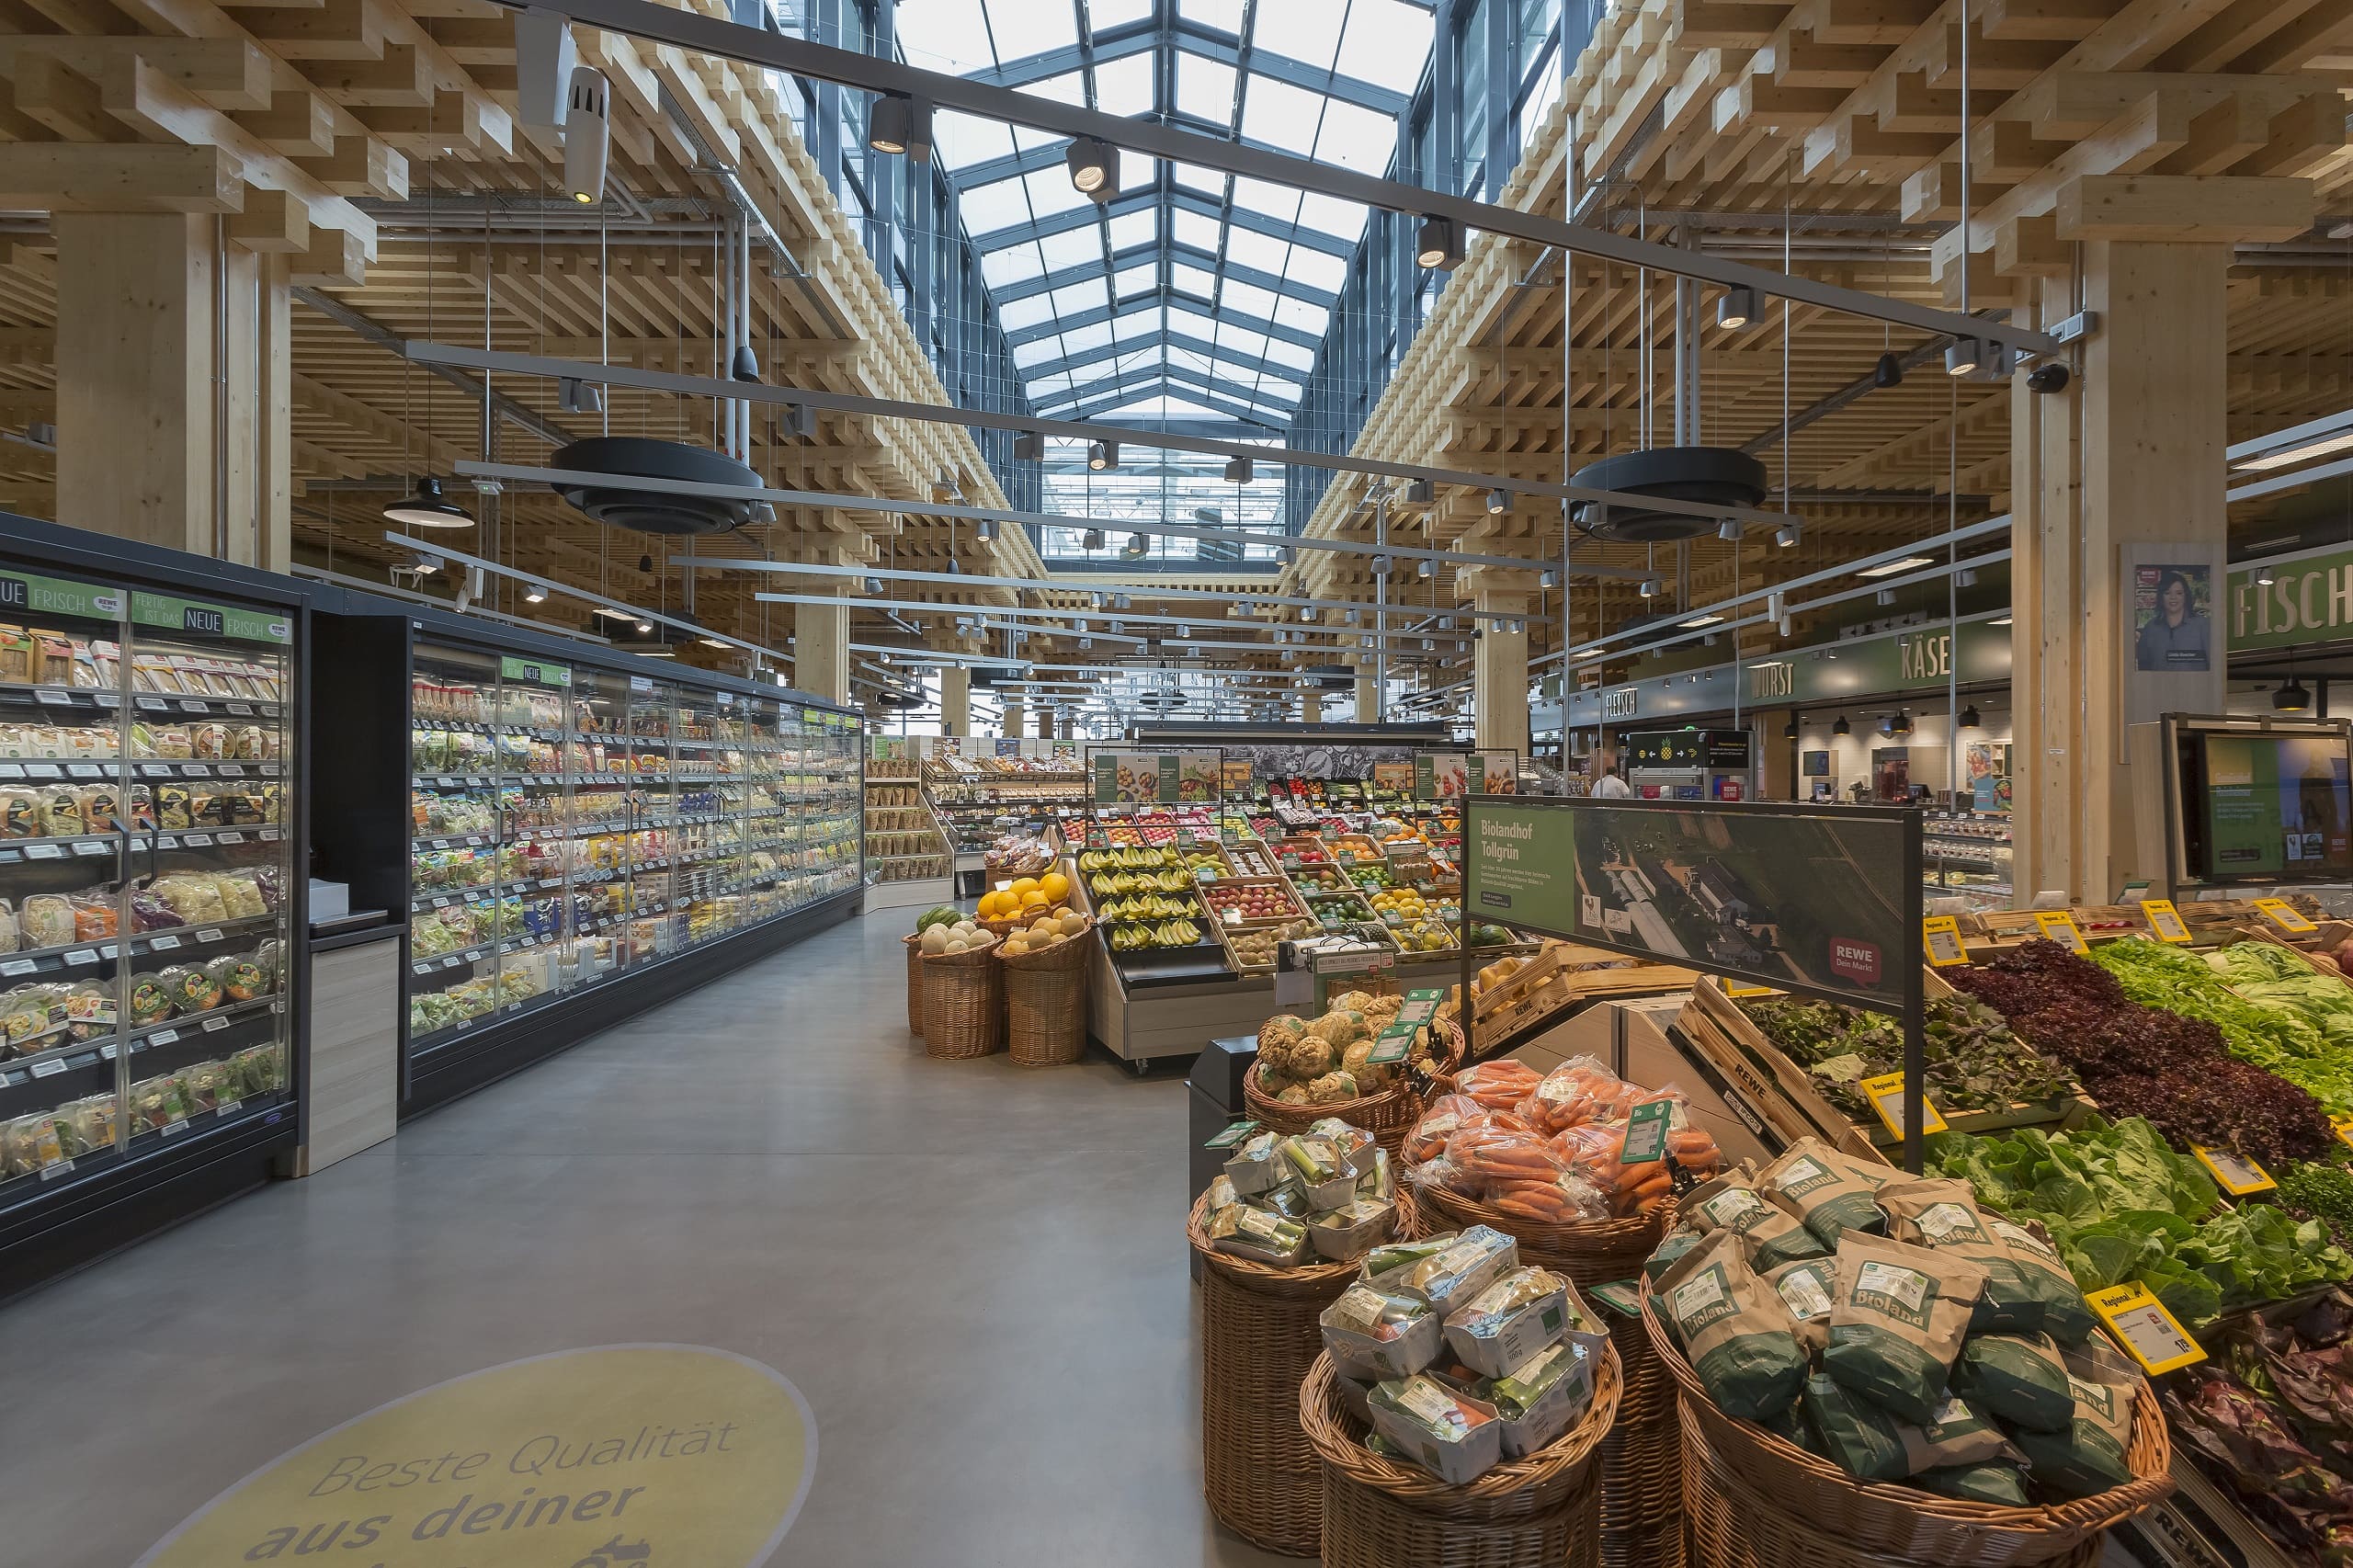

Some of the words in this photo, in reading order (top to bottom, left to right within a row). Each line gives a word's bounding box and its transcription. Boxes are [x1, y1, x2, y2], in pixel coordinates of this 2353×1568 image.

[0, 581, 25, 604] UE
[136, 595, 165, 610] FERTIG
[2234, 564, 2353, 638] FISCH
[144, 610, 158, 622] IST
[163, 613, 180, 625] DAS
[187, 610, 222, 632] NEUE
[1902, 635, 1950, 680] KÄSE
[524, 666, 540, 680] NEUE
[1750, 663, 1793, 699] WURST
[1606, 690, 1637, 718] FLEISCH
[1481, 819, 1533, 840] Biolandhof
[1481, 840, 1519, 862] Tollgrün
[1836, 945, 1873, 962] REWE
[1836, 958, 1851, 969] Dein
[1852, 961, 1874, 972] Markt
[1514, 999, 1534, 1017] REWE
[1734, 1063, 1768, 1100] REWE
[1785, 1173, 1836, 1198] Bioland
[1684, 1300, 1736, 1334] Bioland
[1855, 1290, 1925, 1327] Bioland
[308, 1449, 493, 1498] Beste
[508, 1420, 741, 1475] Qualität
[243, 1514, 392, 1562] aus
[411, 1486, 646, 1542] deiner
